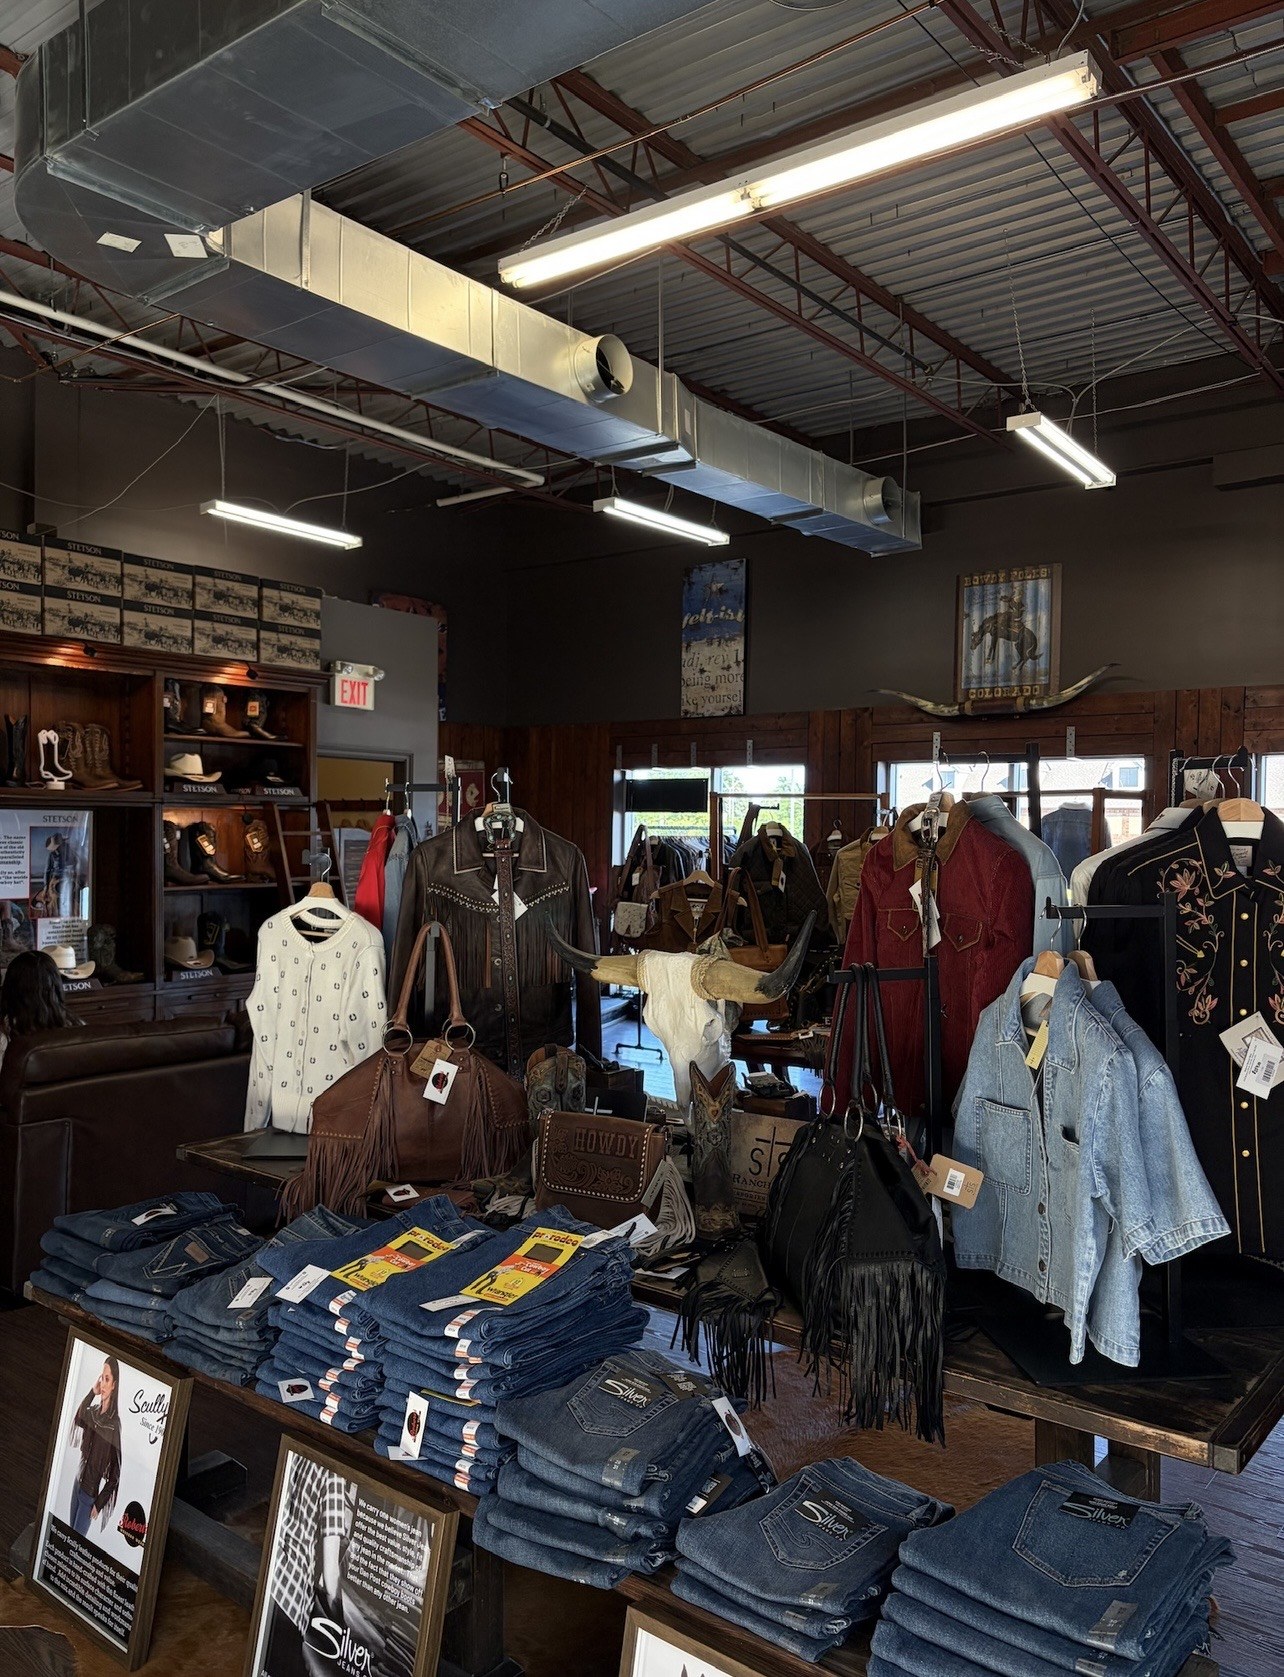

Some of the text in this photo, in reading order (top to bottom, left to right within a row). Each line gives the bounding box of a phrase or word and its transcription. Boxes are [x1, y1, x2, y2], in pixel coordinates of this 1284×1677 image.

[0, 530, 20, 541] SON
[67, 542, 102, 555] STETSON
[143, 559, 174, 570] STETSON
[214, 570, 242, 582] STETSON
[0, 581, 20, 591] SON
[280, 583, 306, 593] STETSON
[67, 591, 101, 603] STETSON
[143, 604, 175, 616] STETSON
[213, 614, 242, 625] STETSON
[277, 625, 305, 636] STETSON
[341, 679, 368, 705] EXIT
[701, 690, 742, 707] yoursel
[968, 685, 1040, 699] COLORADO
[182, 784, 217, 793] STETSON
[43, 815, 78, 823] STETSON
[180, 970, 213, 980] STETSON
[62, 981, 91, 991] ETSON
[575, 1127, 639, 1159] HOWDY
[487, 1287, 518, 1299] Wrangler
[598, 1379, 647, 1408] Silver
[129, 1389, 168, 1424] Scully
[140, 1417, 154, 1432] Since
[358, 1499, 365, 1507] We
[366, 1504, 379, 1516] carry
[379, 1510, 388, 1520] one
[389, 1514, 410, 1531] women's
[794, 1500, 849, 1540] Silver
[1059, 1501, 1129, 1528] Silver
[355, 1519, 367, 1531] offer
[367, 1526, 375, 1535] the
[375, 1530, 386, 1541] best
[356, 1509, 376, 1525] because
[376, 1521, 384, 1529] we
[384, 1524, 402, 1538] believe
[402, 1533, 416, 1546] Silver
[353, 1529, 362, 1540] and
[362, 1534, 379, 1550] quality
[379, 1543, 415, 1570] craftsmanship
[360, 1545, 371, 1558] jean
[371, 1551, 376, 1559] in
[376, 1554, 385, 1564] the
[350, 1551, 359, 1561] and
[359, 1556, 367, 1566] the
[368, 1561, 378, 1572] fact
[378, 1567, 388, 1577] that
[389, 1573, 400, 1585] they
[400, 1579, 414, 1592] show
[348, 1562, 415, 1604] your Dan Post cowboy boots
[347, 1572, 409, 1614] better than any other jean.
[305, 1617, 372, 1677] Silver
[336, 1659, 361, 1677] JEANS
